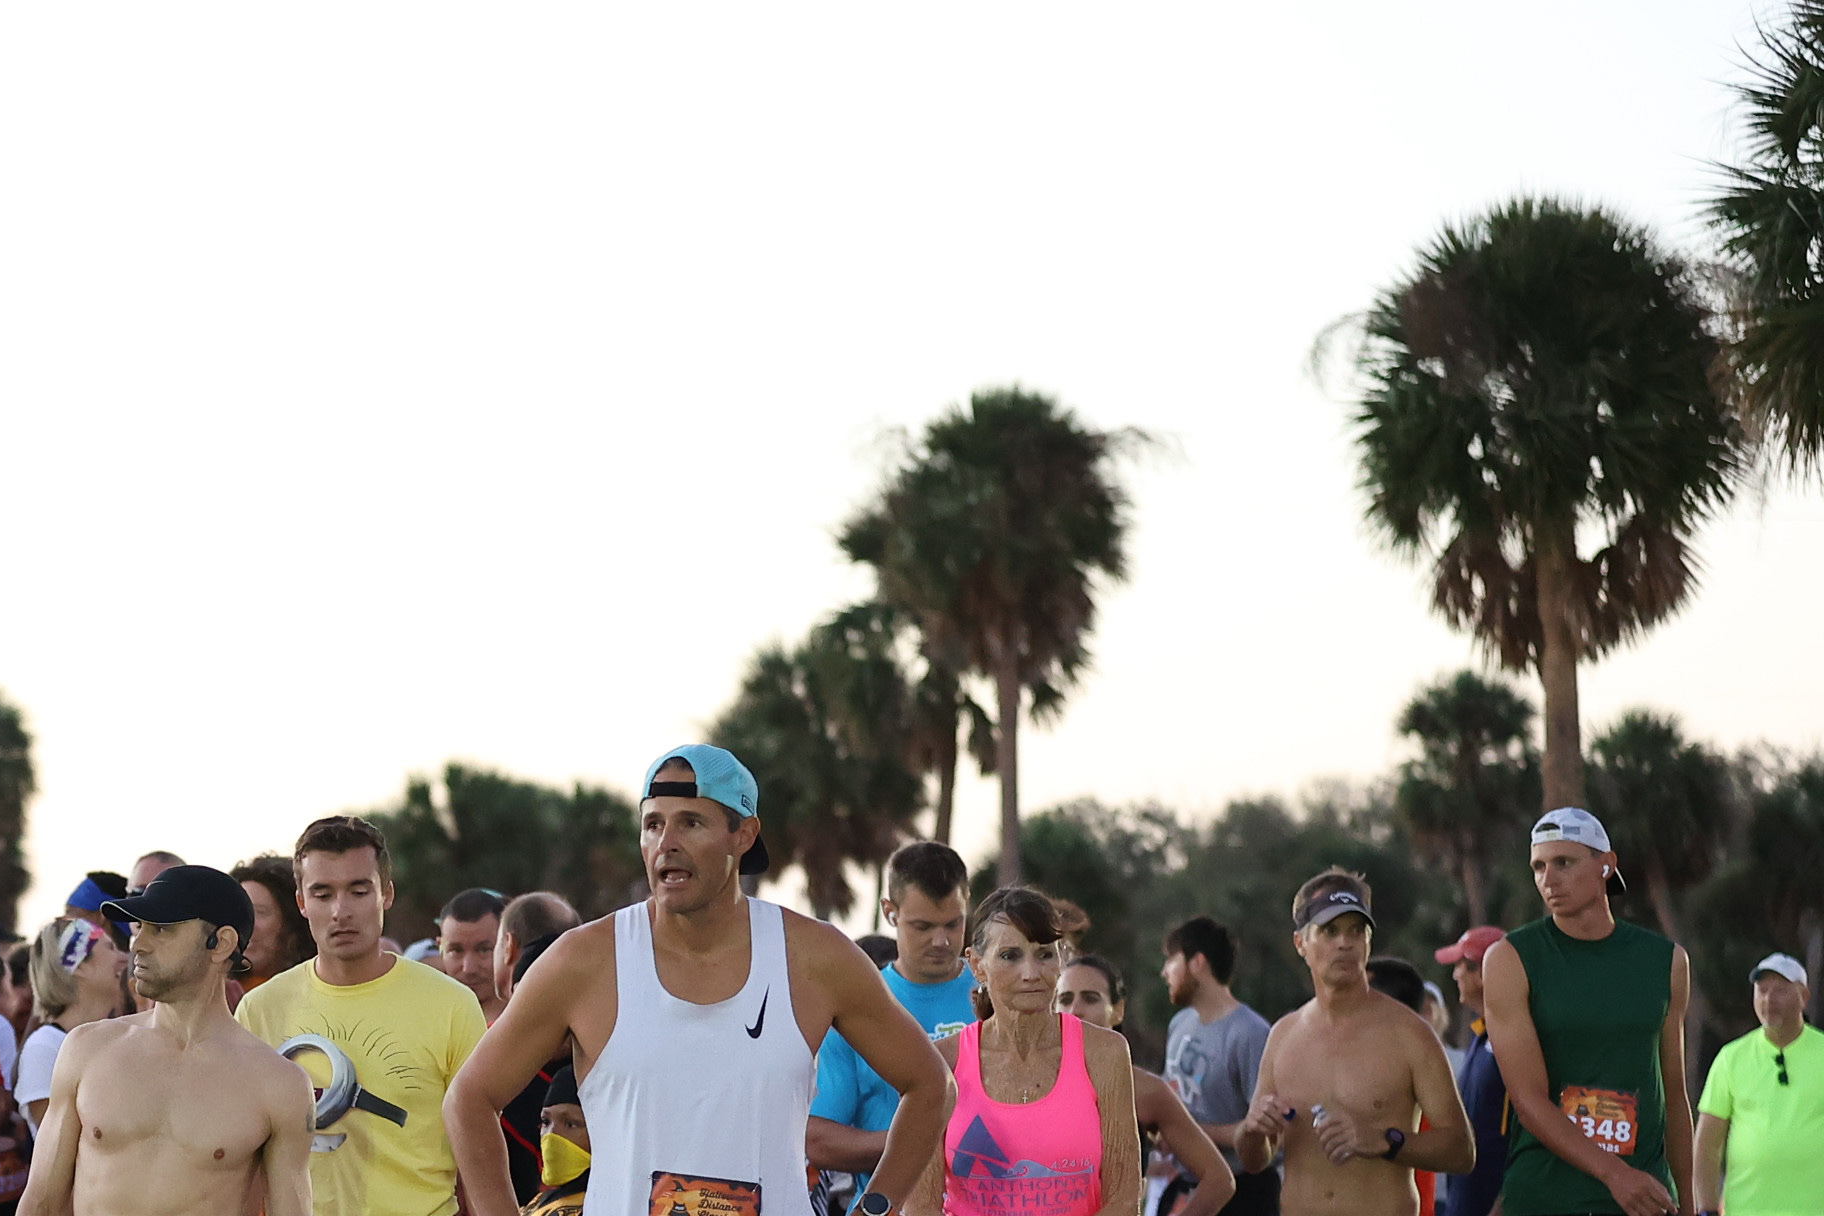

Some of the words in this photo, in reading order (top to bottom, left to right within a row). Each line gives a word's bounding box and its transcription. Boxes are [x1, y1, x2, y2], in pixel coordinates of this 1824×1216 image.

[1567, 1114, 1631, 1142] 348
[698, 1199, 743, 1212] Distance
[960, 1186, 1088, 1209] TRIATHLON
